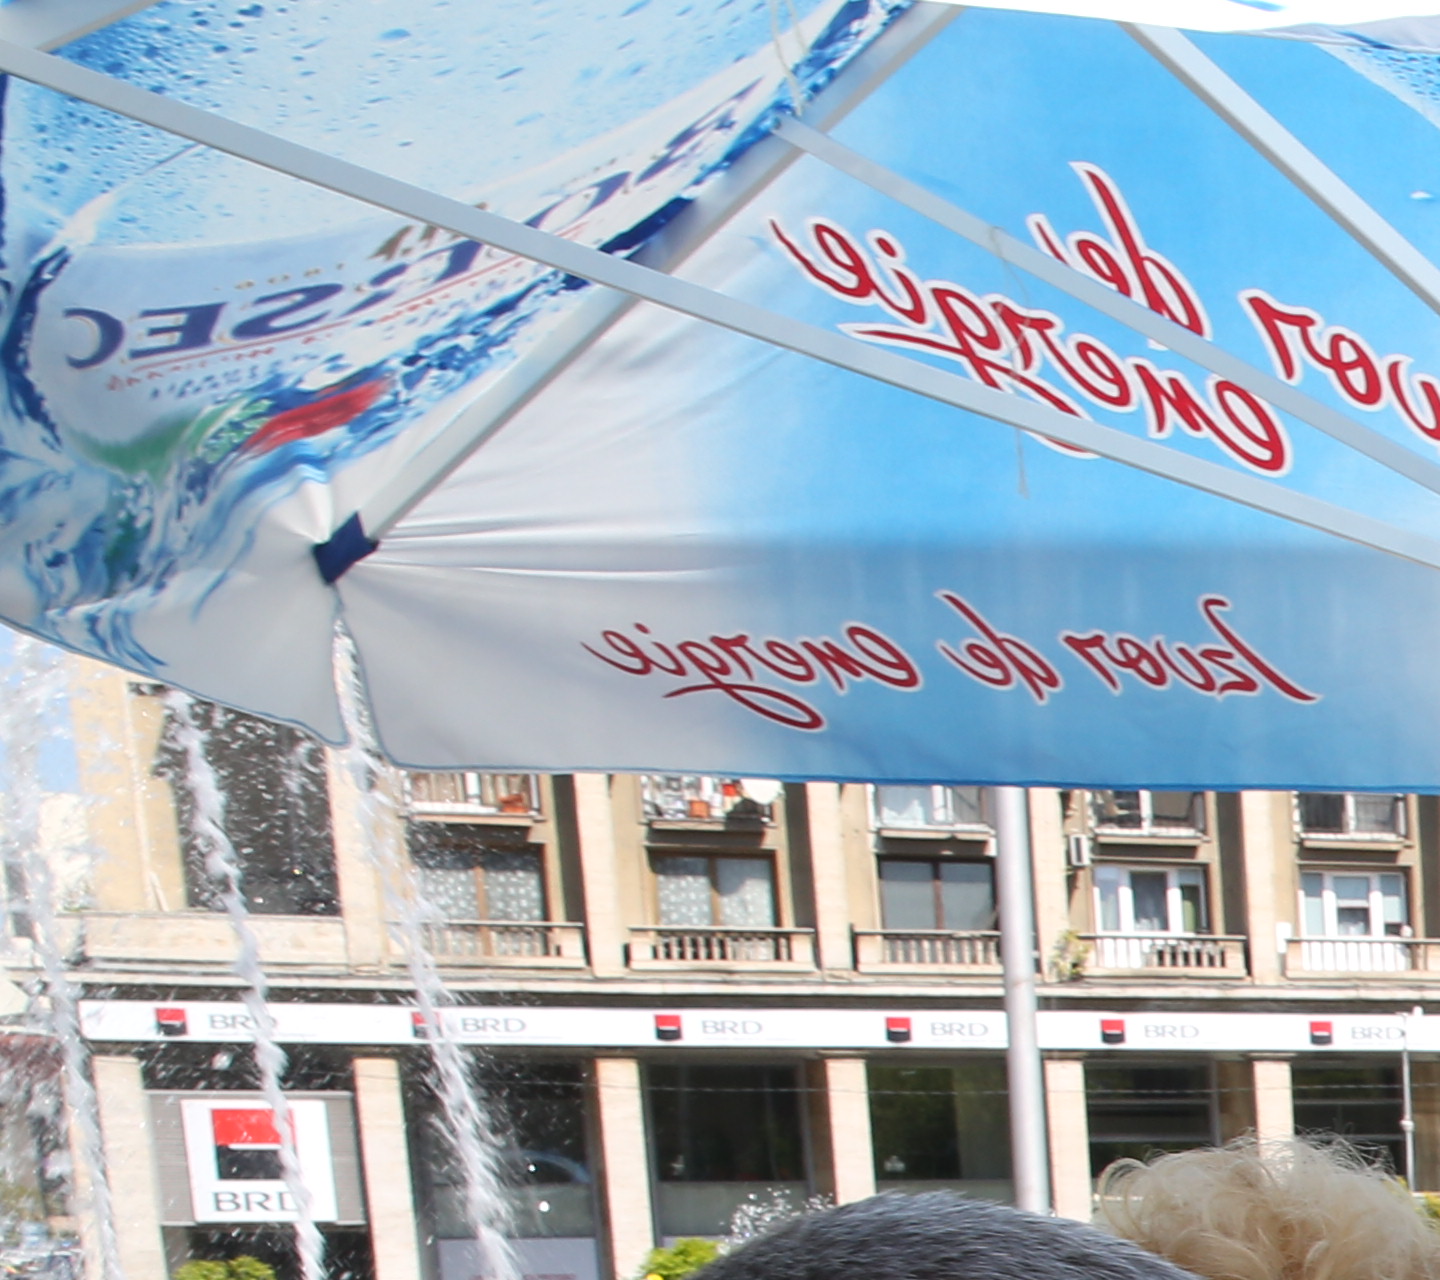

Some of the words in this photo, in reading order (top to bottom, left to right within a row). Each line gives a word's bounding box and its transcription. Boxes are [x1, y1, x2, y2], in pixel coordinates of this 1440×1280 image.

[461, 1017, 528, 1034] BRD
[701, 1019, 763, 1035] BRD
[929, 1020, 990, 1039] BRD
[1143, 1022, 1201, 1041] BRD
[1350, 1024, 1406, 1041] BRD
